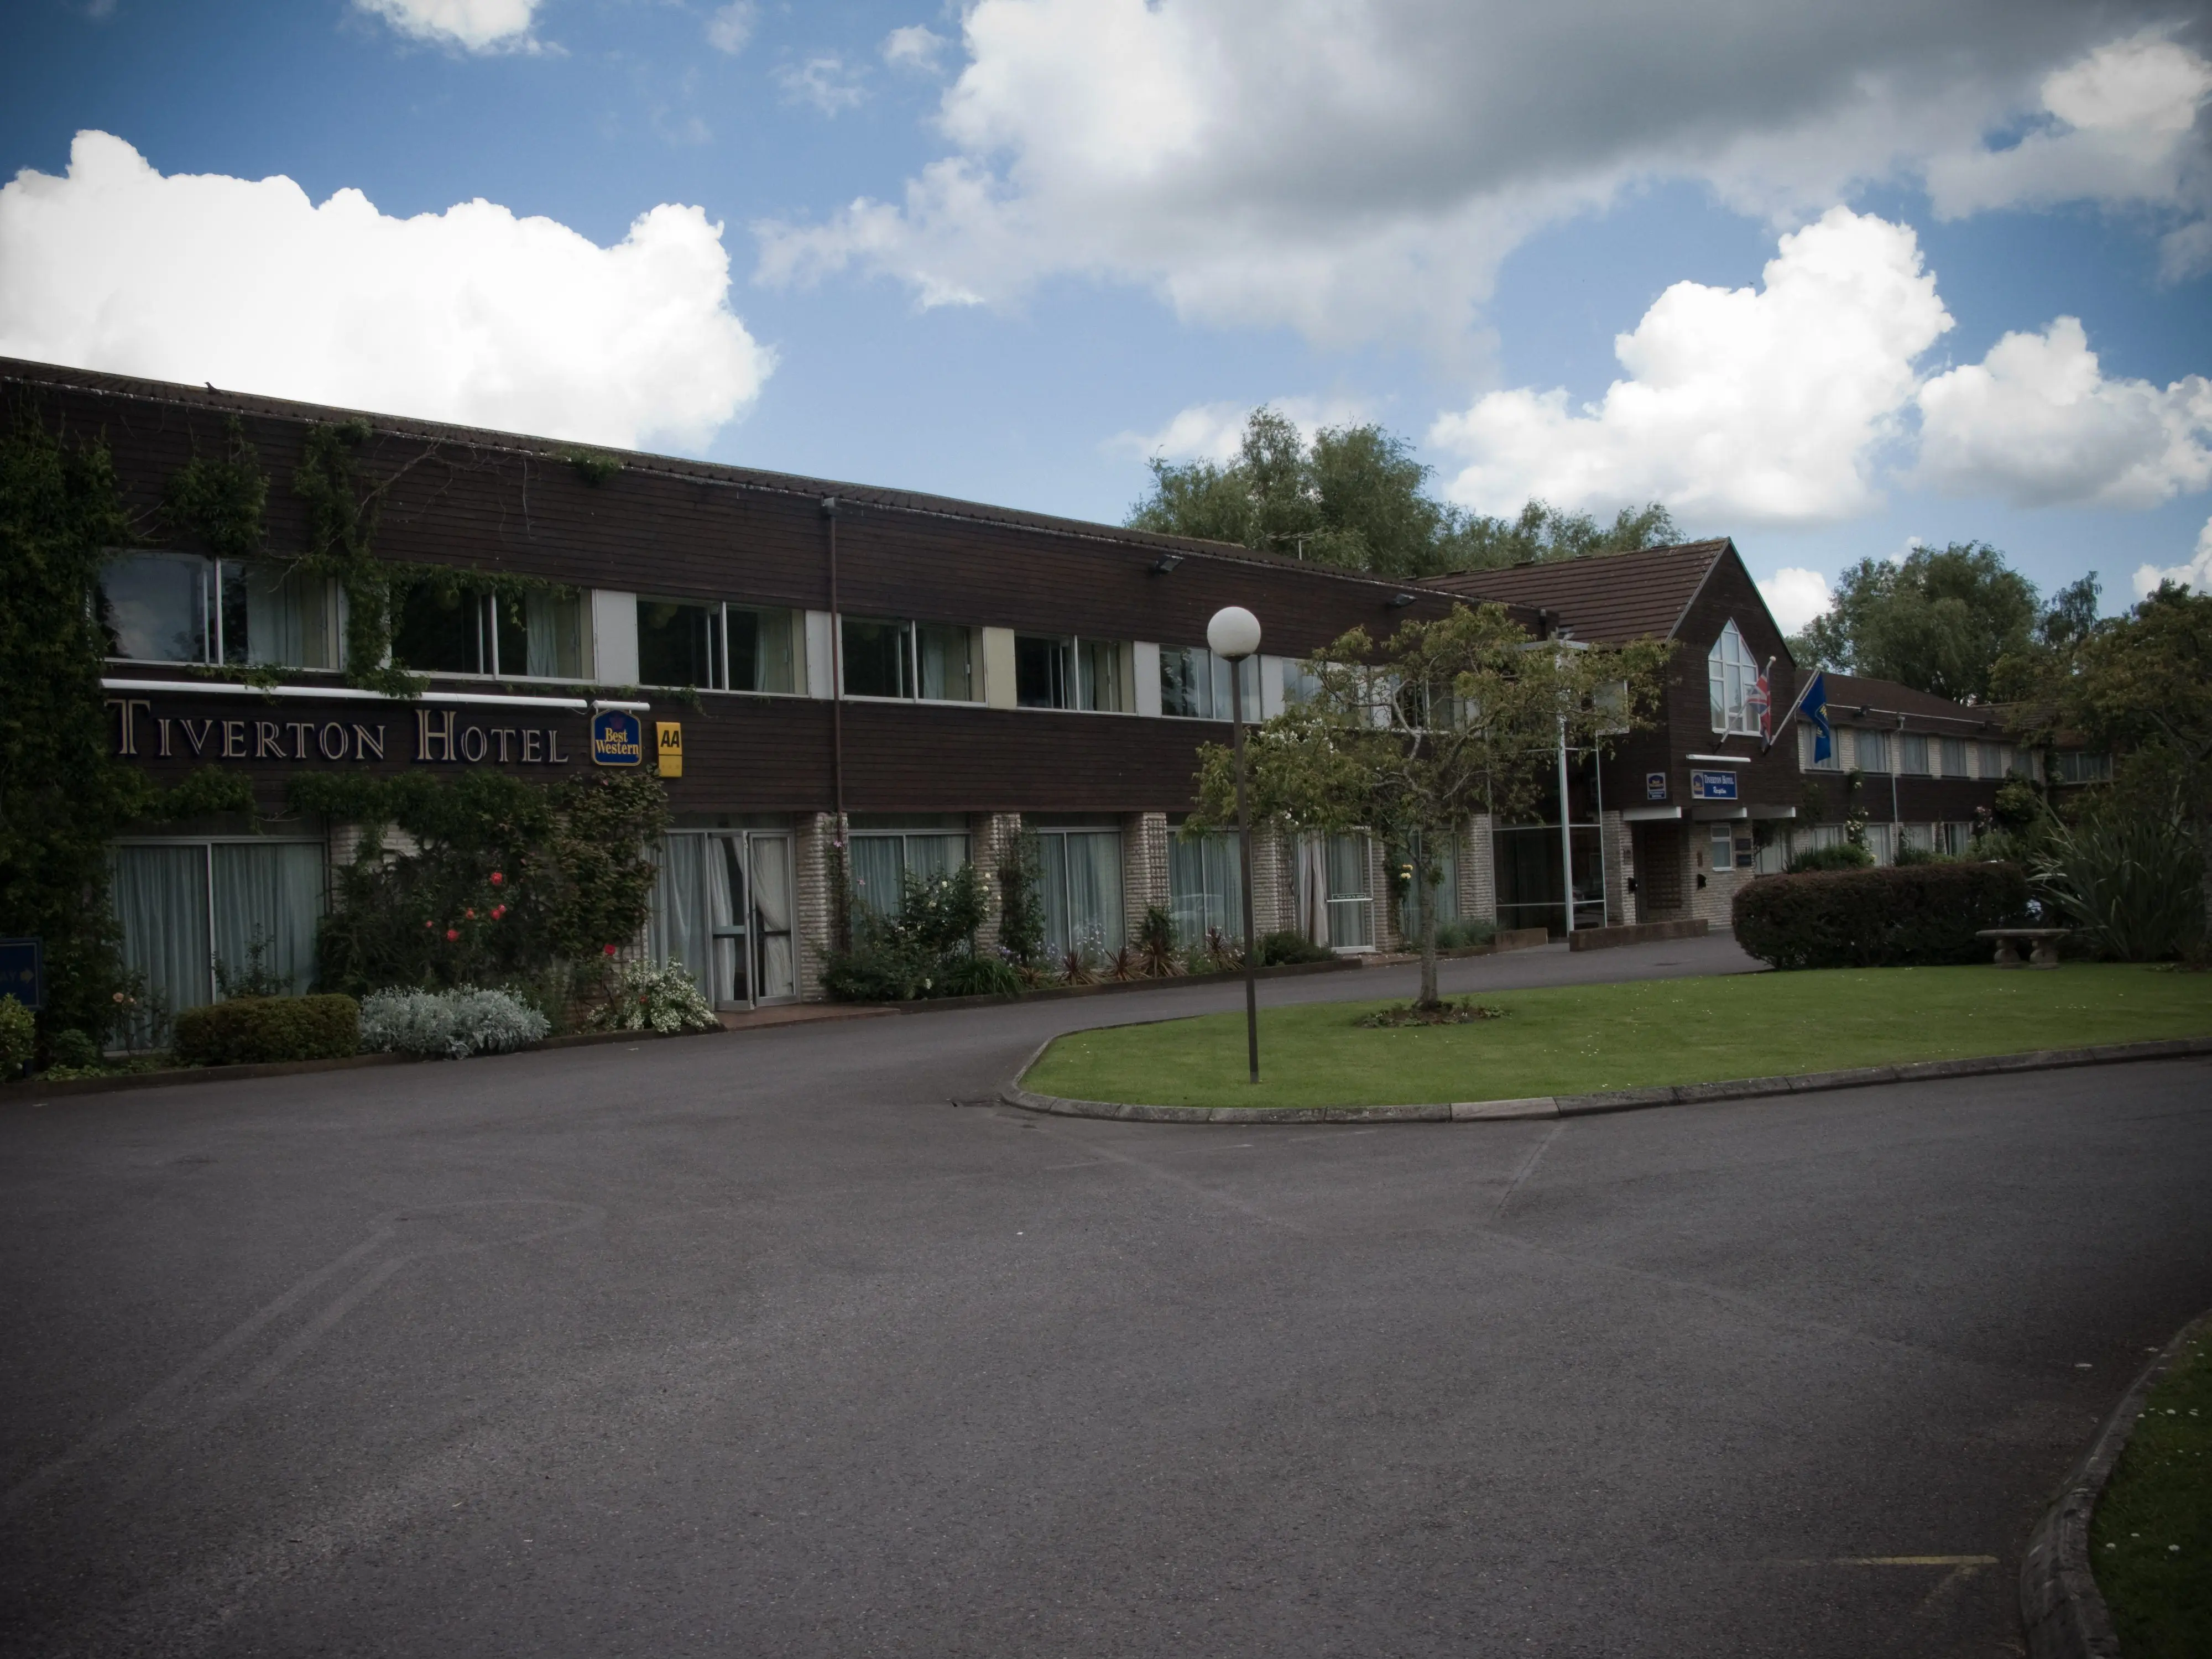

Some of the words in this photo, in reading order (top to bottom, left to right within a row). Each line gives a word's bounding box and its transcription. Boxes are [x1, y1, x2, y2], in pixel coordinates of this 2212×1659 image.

[106, 698, 385, 760] TIVERTON
[415, 709, 568, 763] HOTEL
[604, 727, 628, 742] Best
[660, 729, 680, 748] AA
[595, 739, 639, 755] Western
